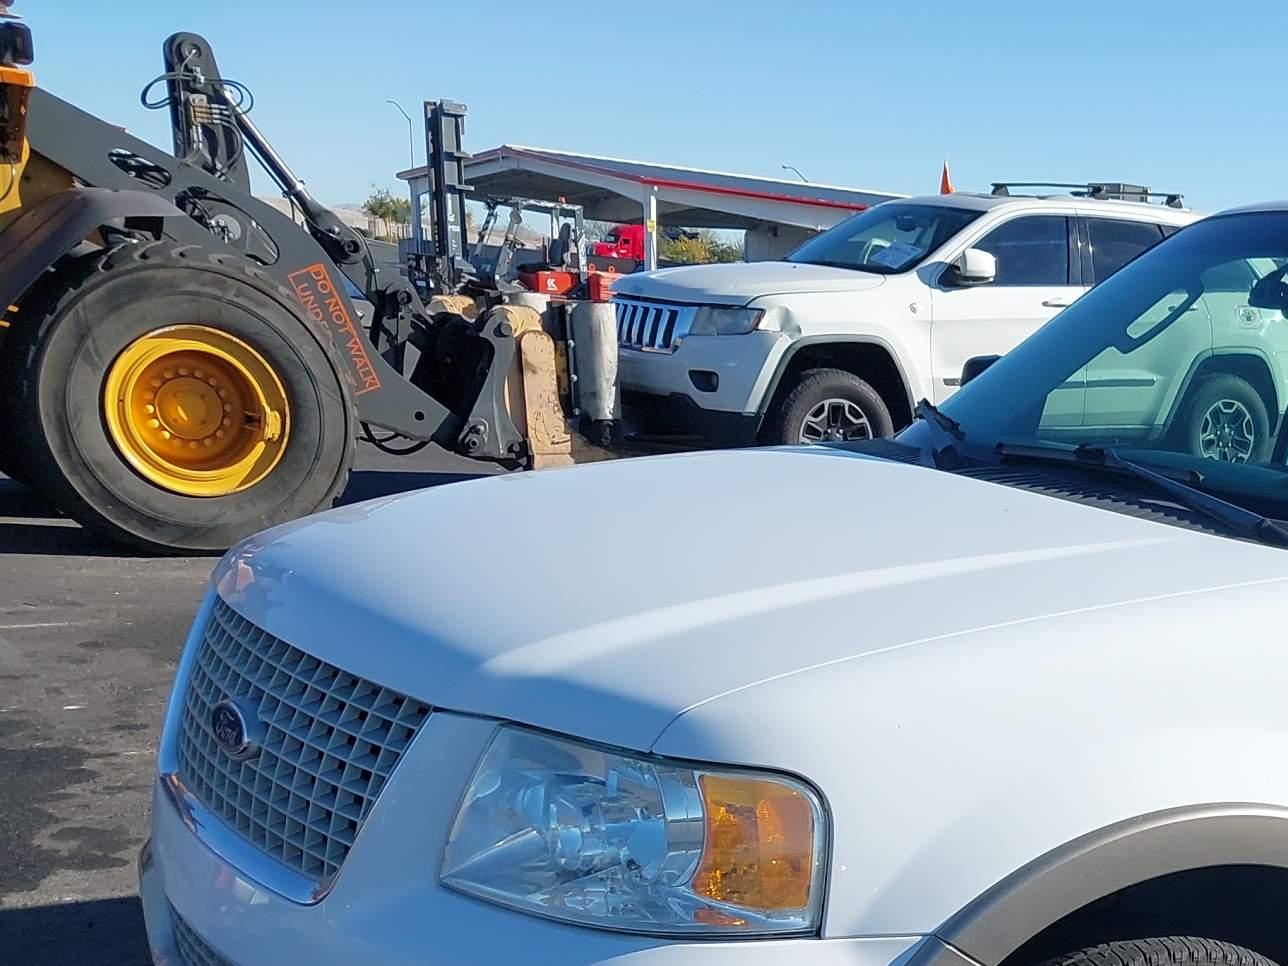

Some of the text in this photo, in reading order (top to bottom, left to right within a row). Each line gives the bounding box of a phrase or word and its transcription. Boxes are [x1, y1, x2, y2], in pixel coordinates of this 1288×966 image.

[309, 267, 331, 294] DO
[324, 298, 353, 337] NOT
[346, 338, 379, 389] WALK
